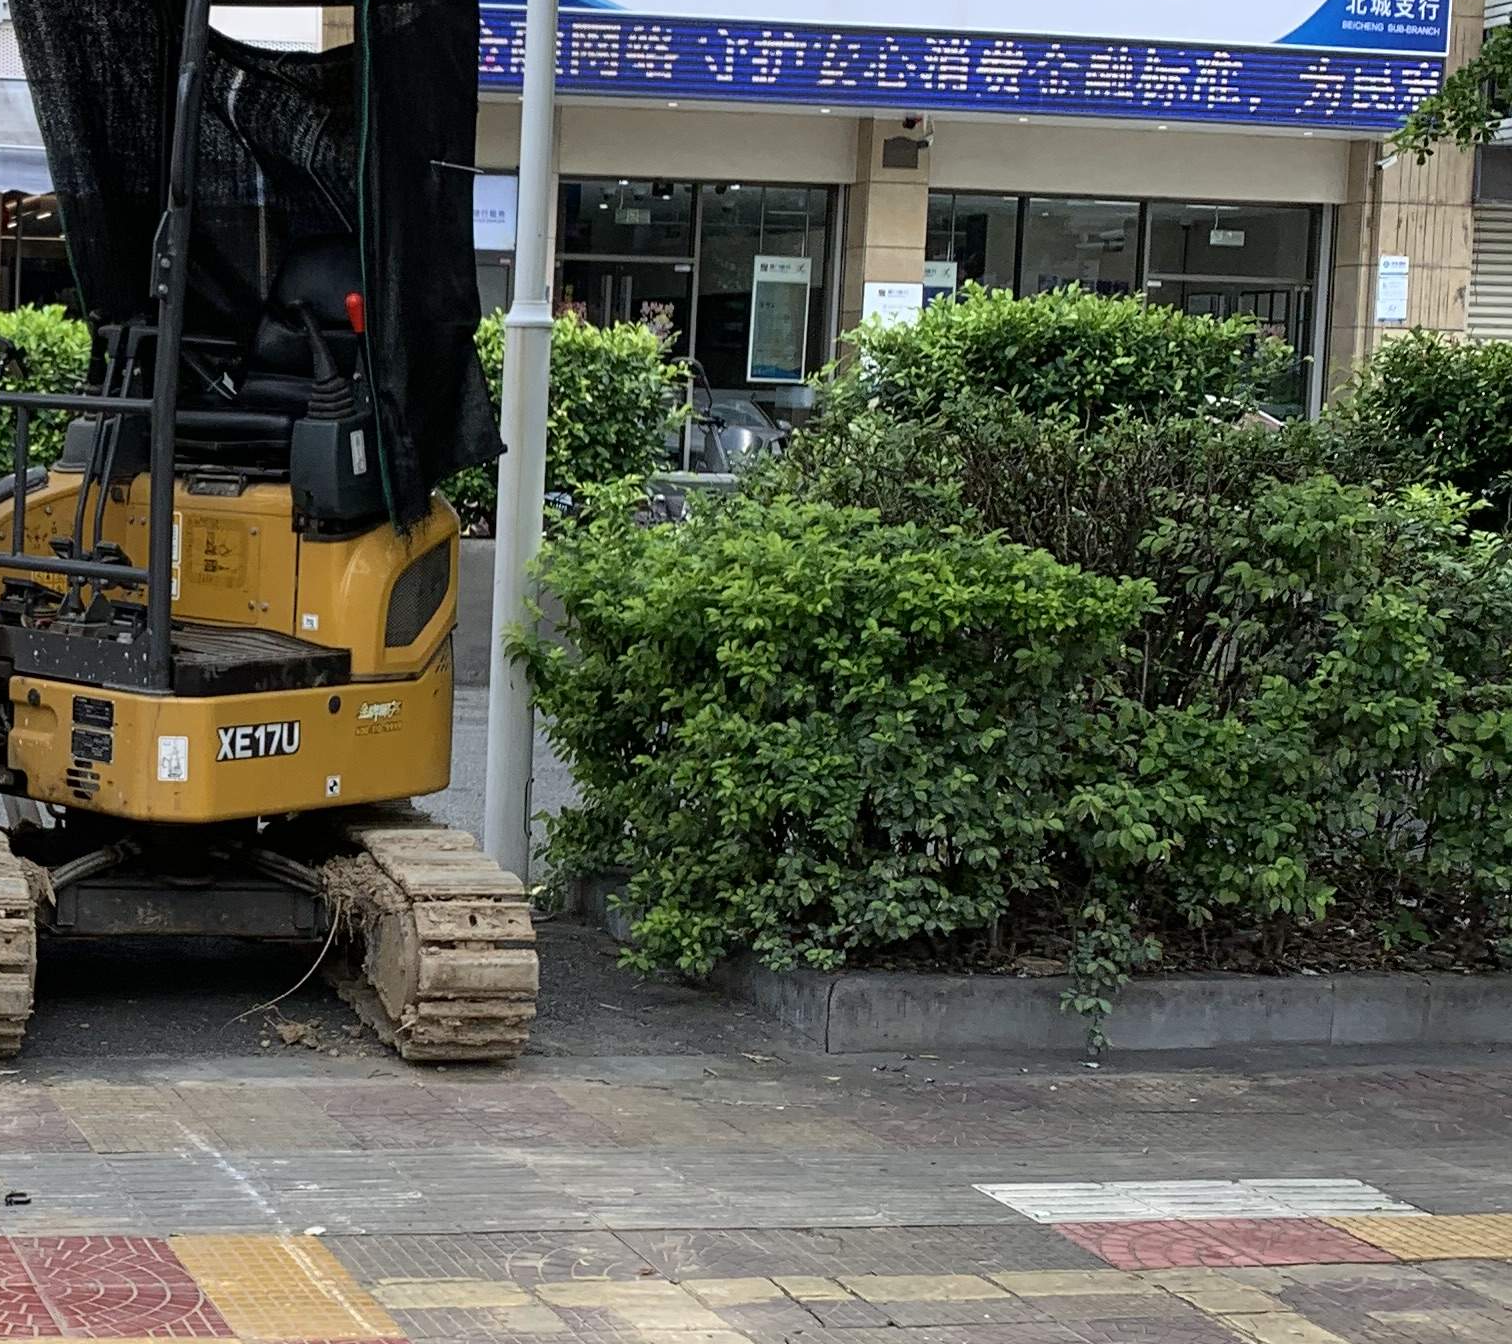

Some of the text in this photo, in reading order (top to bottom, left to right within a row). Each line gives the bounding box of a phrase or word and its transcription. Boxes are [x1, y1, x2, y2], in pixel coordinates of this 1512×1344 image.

[1342, 20, 1441, 36] BEICHENG SUB-BRANCH
[216, 721, 300, 761] XE17U
